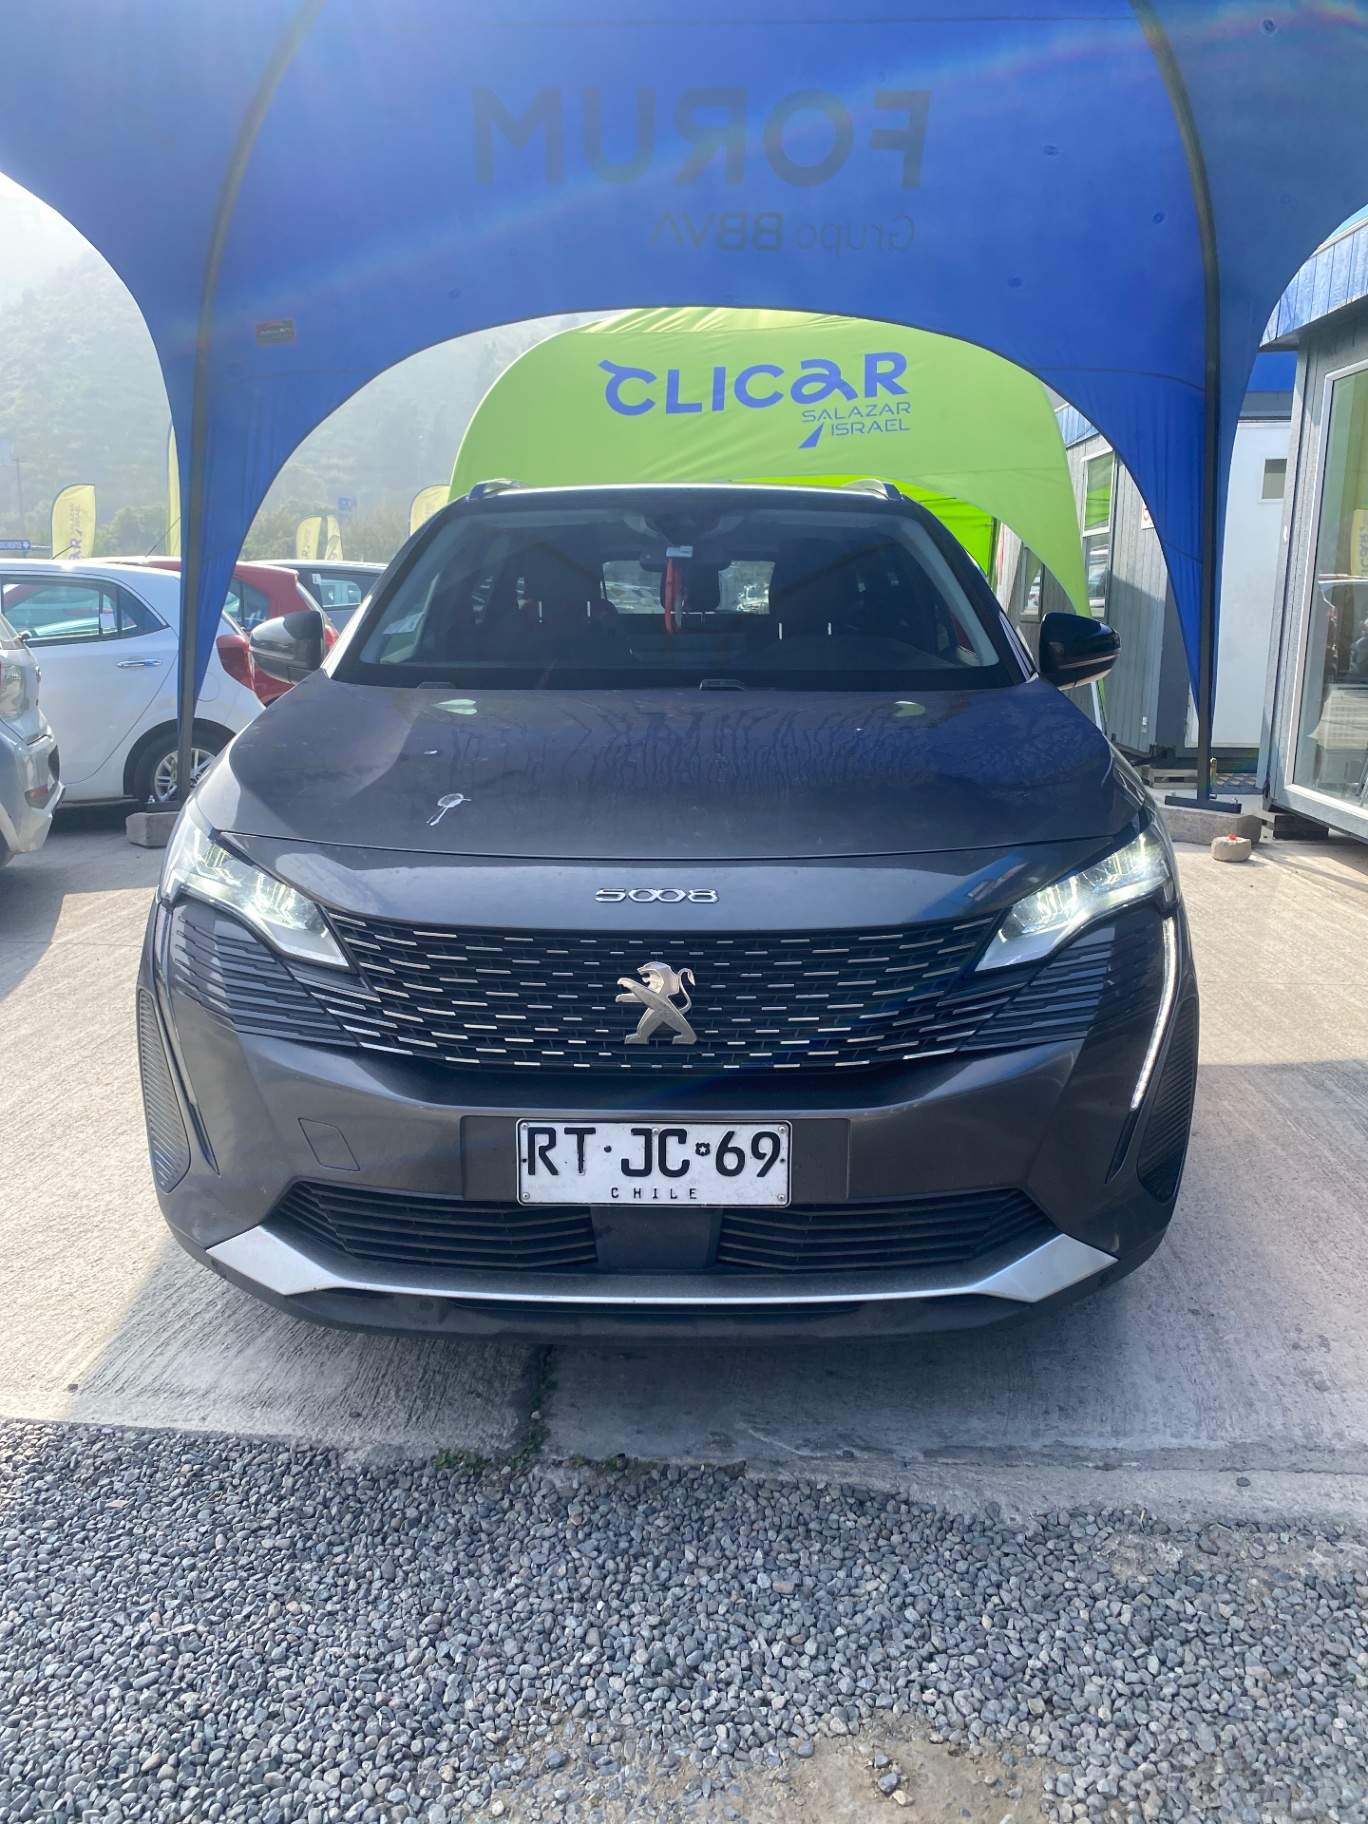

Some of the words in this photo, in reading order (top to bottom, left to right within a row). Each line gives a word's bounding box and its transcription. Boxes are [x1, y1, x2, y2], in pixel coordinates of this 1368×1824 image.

[801, 401, 911, 424] SALAZAR
[831, 417, 911, 437] ISRAEL
[595, 887, 719, 904] 5008
[611, 1186, 698, 1200] CHILE
